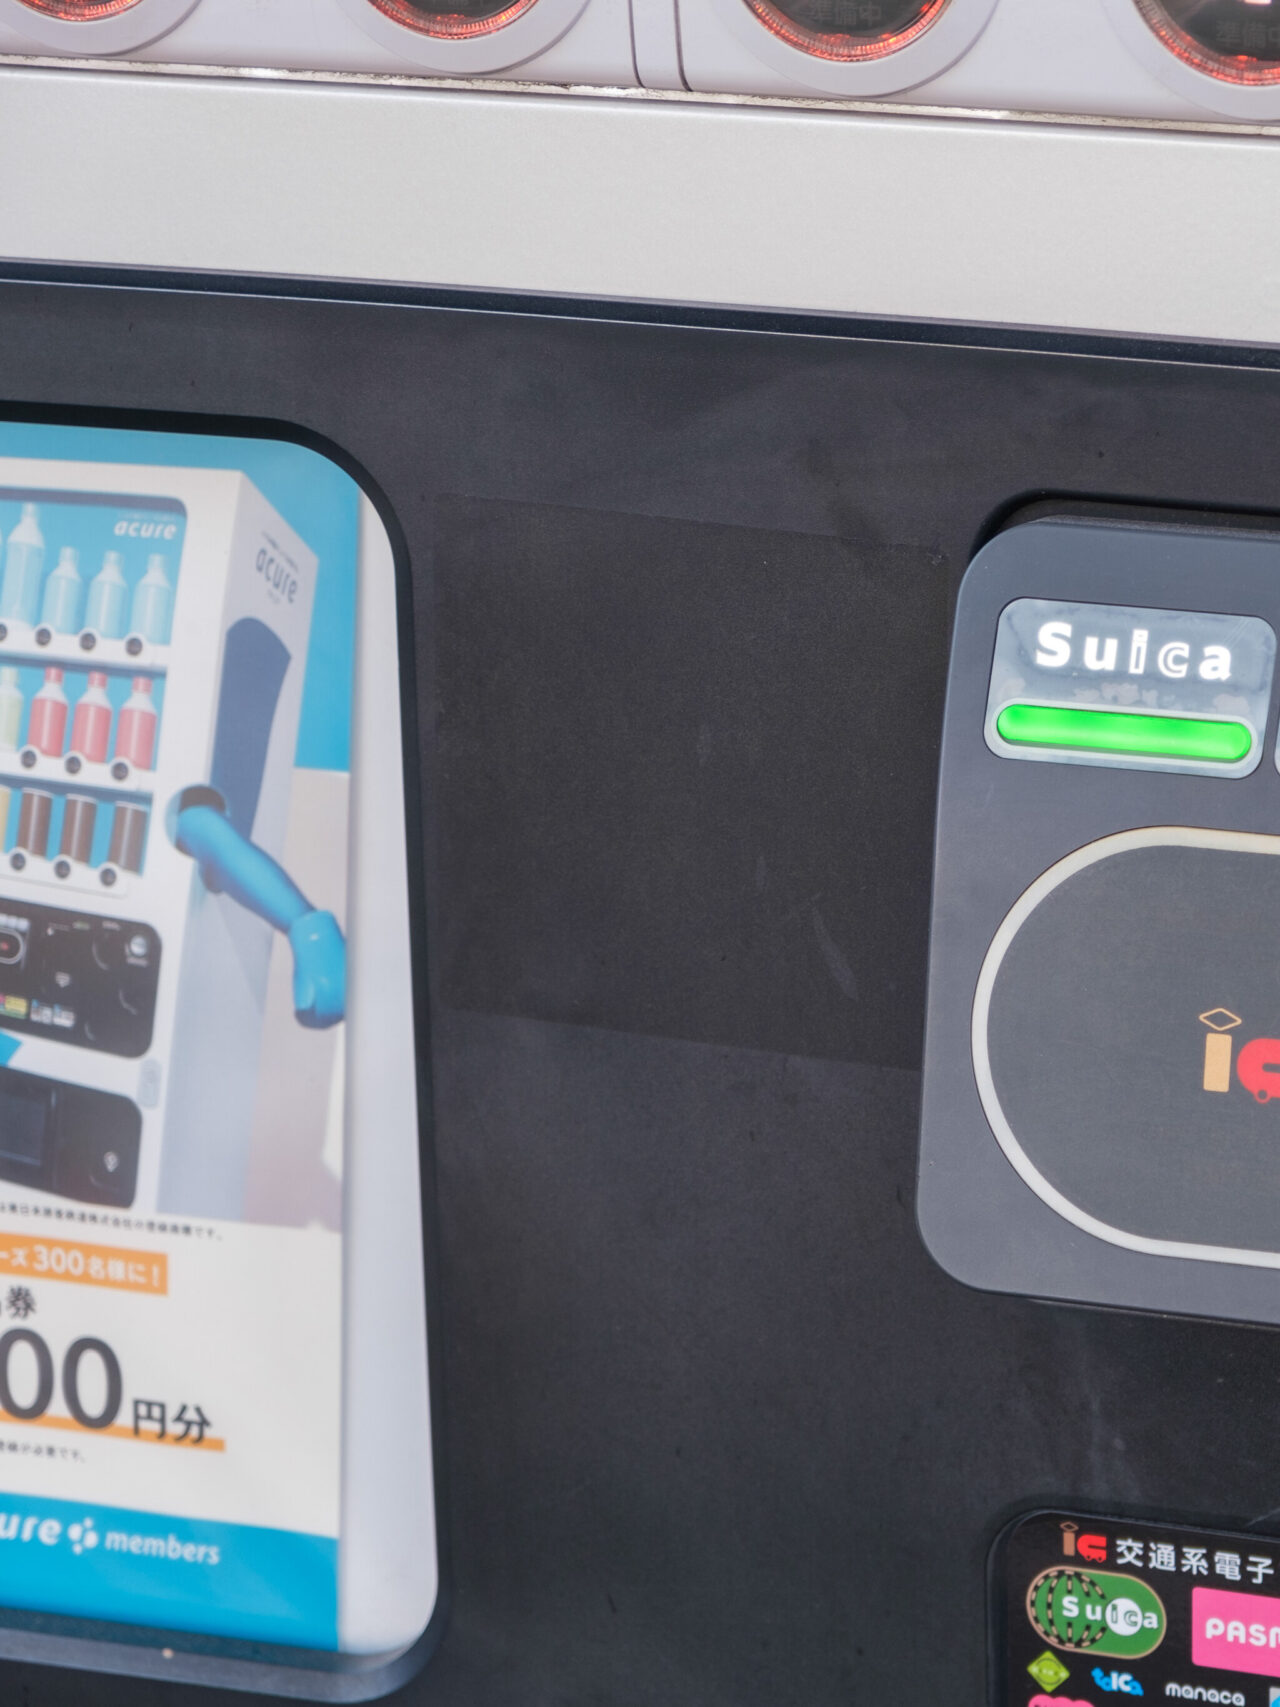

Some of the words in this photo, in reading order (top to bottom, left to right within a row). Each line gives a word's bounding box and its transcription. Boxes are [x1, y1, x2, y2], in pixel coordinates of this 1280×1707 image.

[114, 520, 177, 540] acure
[256, 548, 298, 604] acure
[1035, 621, 1232, 680] Suica
[104, 1530, 220, 1565] members
[1062, 1596, 1159, 1630] Suica
[1165, 1683, 1246, 1707] manaca
